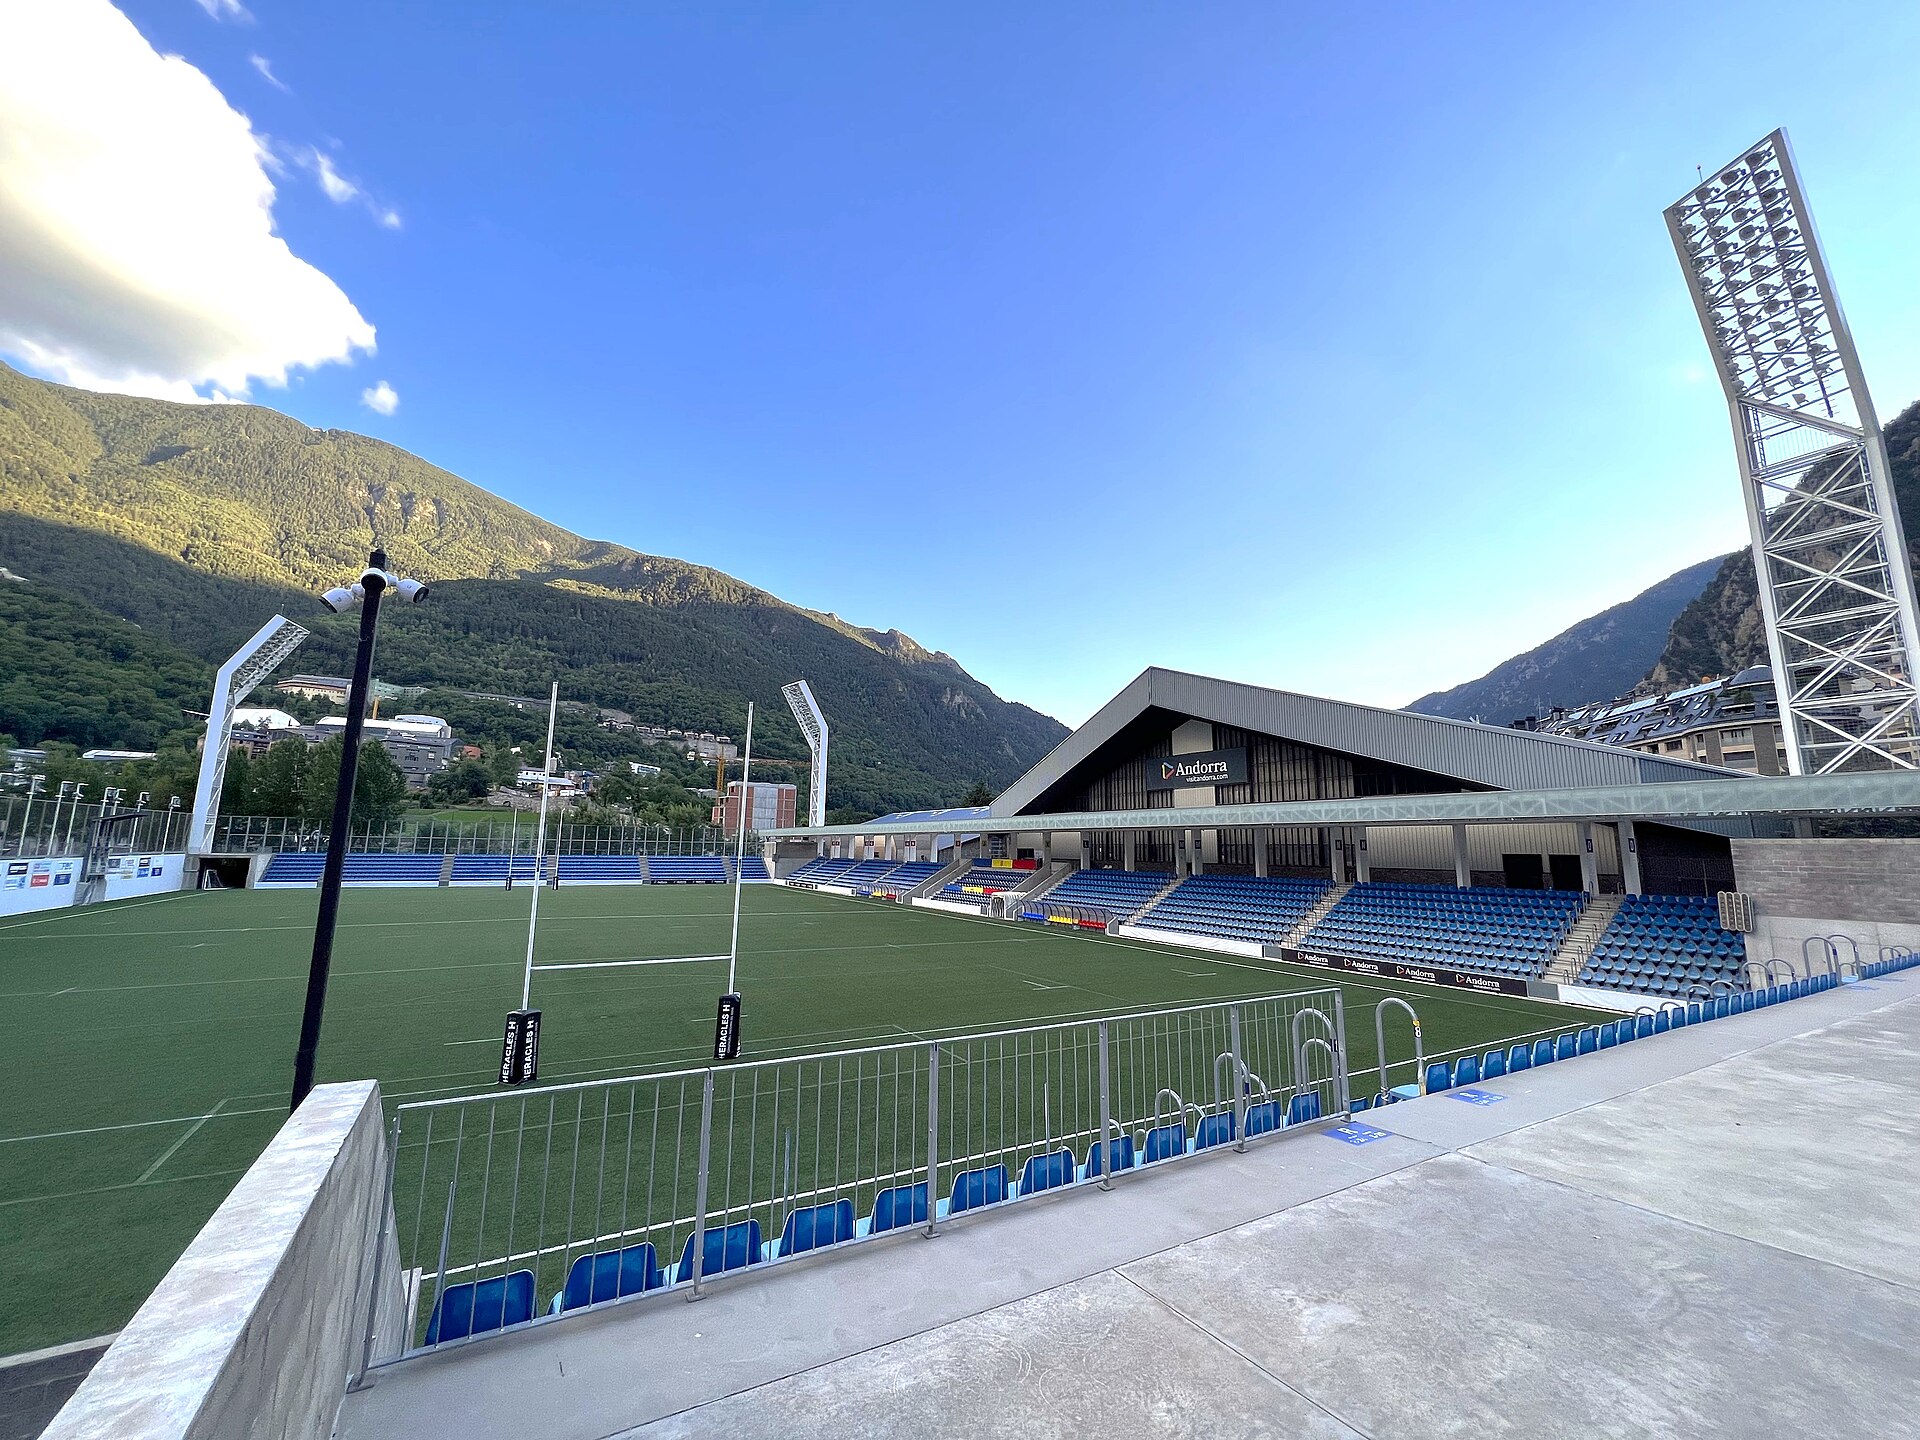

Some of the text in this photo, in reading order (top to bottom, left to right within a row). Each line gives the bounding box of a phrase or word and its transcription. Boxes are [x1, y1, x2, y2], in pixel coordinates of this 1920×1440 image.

[1175, 760, 1227, 776] Andorra
[1186, 774, 1228, 782] visitandorra.com
[1304, 953, 1329, 964] Andorra
[1351, 960, 1379, 971] Andorra
[1405, 967, 1436, 979] Andorra
[1465, 975, 1500, 988] Andorra
[718, 1013, 730, 1059] HERACLES
[502, 1031, 515, 1083] HERACLES
